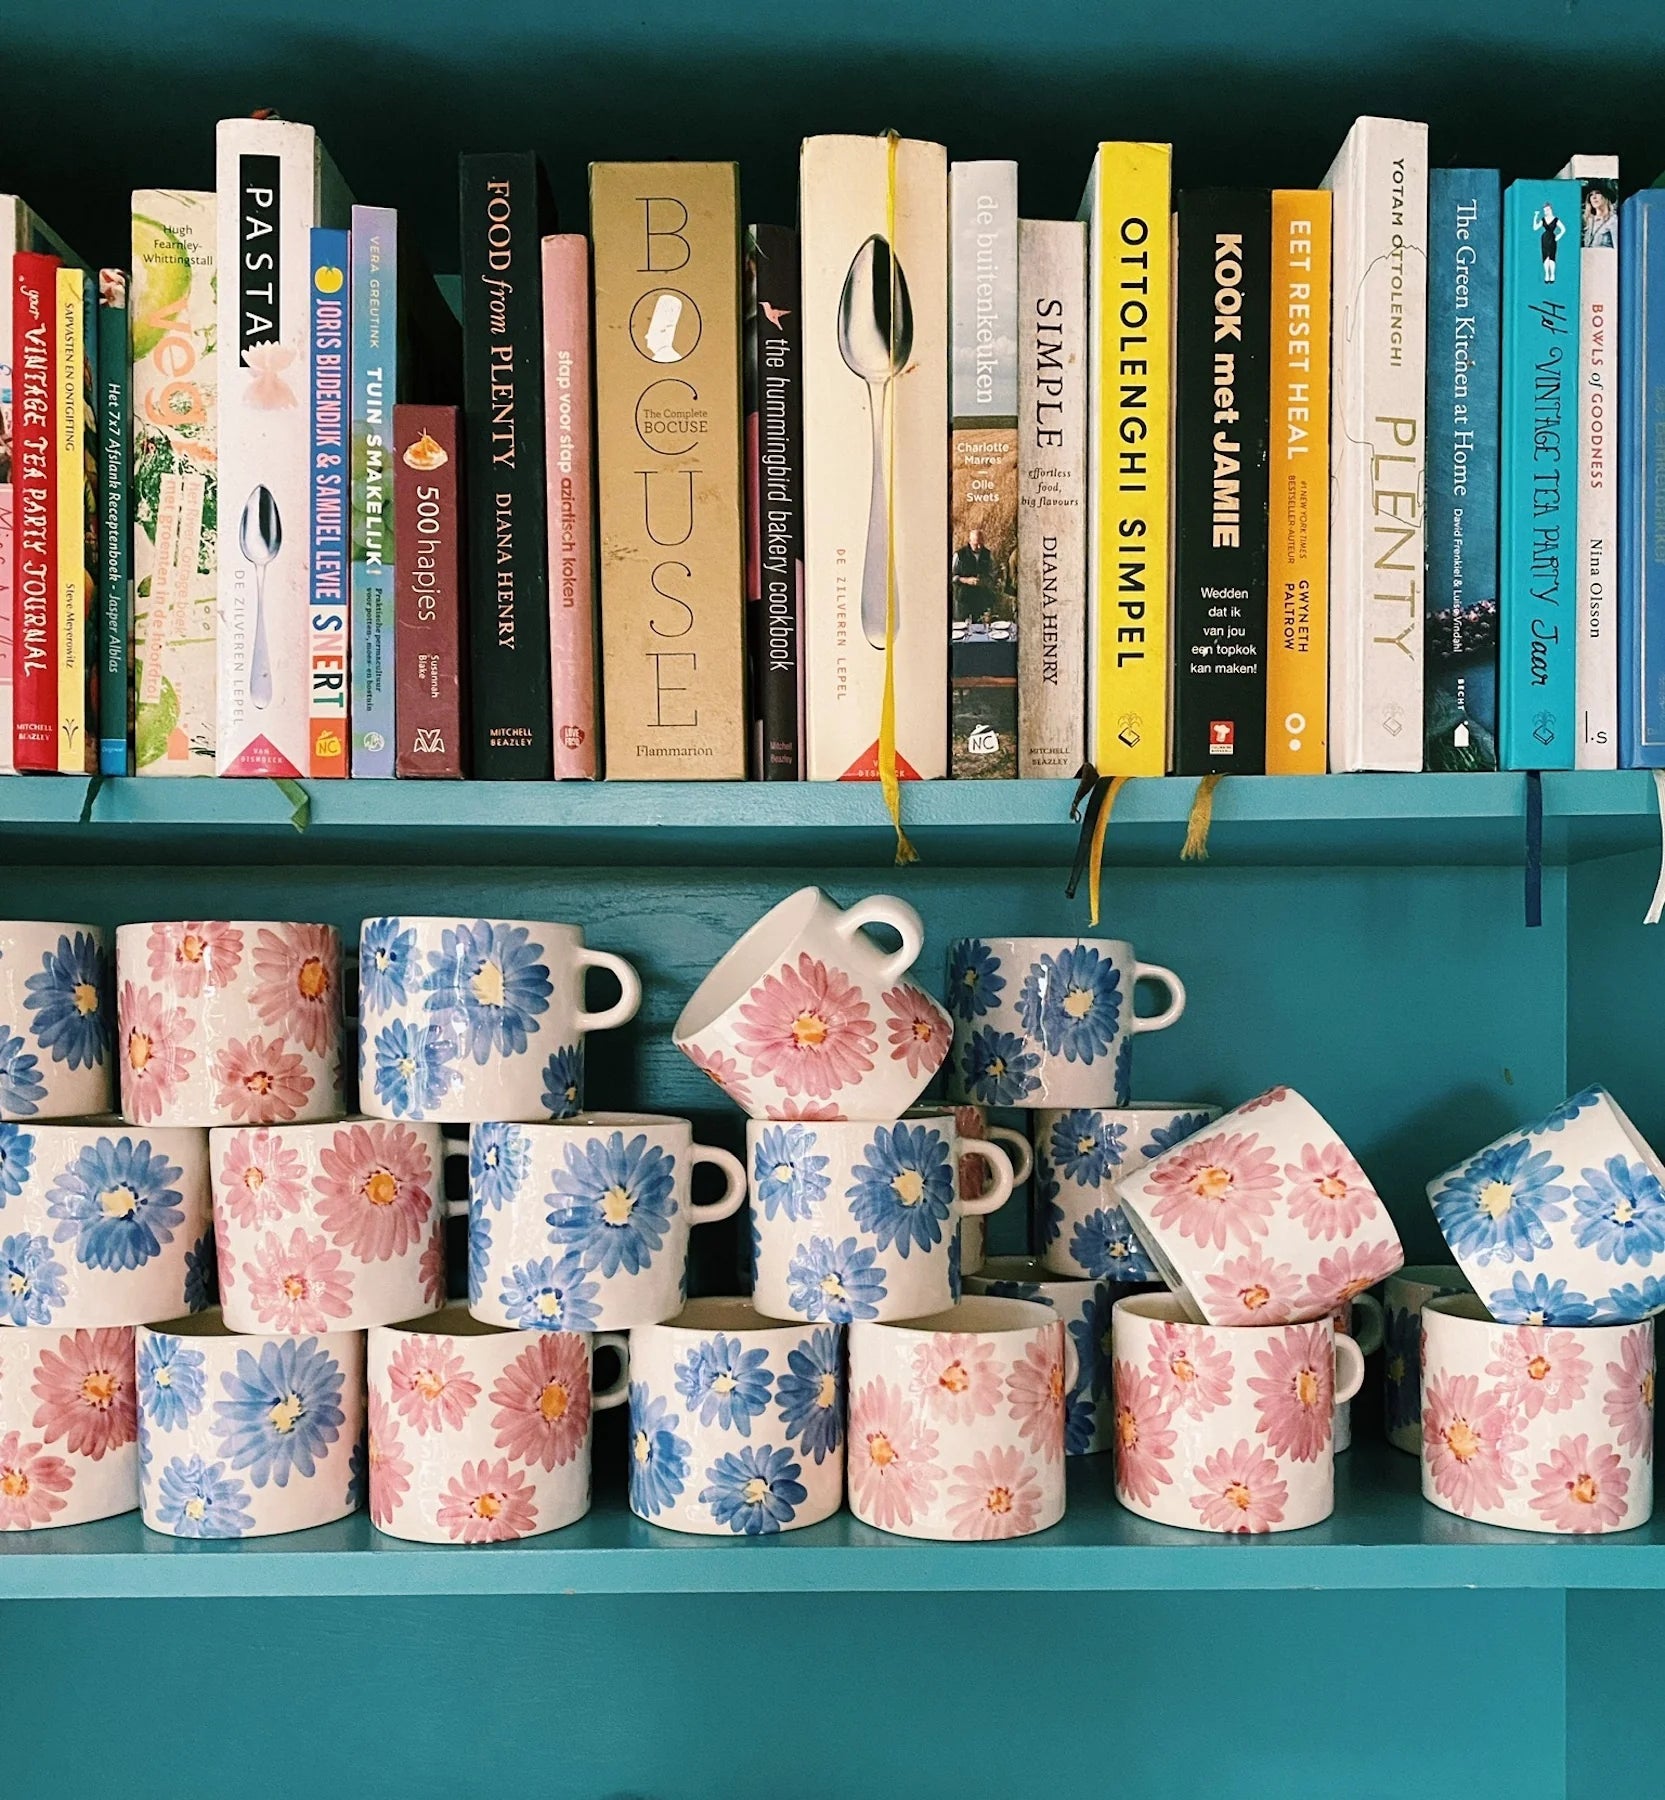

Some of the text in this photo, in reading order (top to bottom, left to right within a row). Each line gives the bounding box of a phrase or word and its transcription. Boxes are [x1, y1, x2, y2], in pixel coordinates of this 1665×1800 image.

[154, 239, 203, 252] Fearnley-
[163, 224, 193, 236] Hugh
[143, 254, 213, 267] Whittingstall
[246, 188, 273, 335] PASTA
[1390, 158, 1404, 367] YOTAM OTTOLENGHI
[369, 236, 380, 348] VERA GREUTINK
[977, 195, 998, 404] de buitenkeuken
[1287, 220, 1312, 460] EET RESET HEAL
[1454, 199, 1477, 496] The Green Kitchen at Home
[23, 322, 47, 428] VINTAGE
[64, 302, 75, 451] SAPVASTEN EN ONTGIFTING
[108, 383, 121, 406] Het
[1036, 298, 1063, 448] SIMPLE
[1212, 233, 1243, 548] KOOK met JAMIE
[108, 410, 121, 436] 7x7
[481, 180, 516, 649] FOOD from PLENTY DIANA HENRY
[643, 408, 708, 420] The Complete
[1533, 346, 1563, 462] VINTAGE
[316, 299, 341, 599] JORIS BIJDENDIJK & SAMUEL LEVIE
[644, 421, 708, 434] BOCUSE
[957, 443, 1009, 453] Charlotte
[1117, 217, 1149, 668] OTTOLENGHI SIMPEL
[23, 436, 48, 480] TEA
[105, 438, 121, 486] Afslank
[366, 367, 383, 575] TUIN SMAKELIJK!
[557, 351, 577, 608] stap voor stap aziatisch koken
[629, 197, 704, 726] BOCUSE
[964, 456, 1002, 465] Marres
[1028, 468, 1071, 480] effortless
[1589, 304, 1604, 638] BOWLS of GOODNESS Nina Olsson
[762, 338, 794, 671] the hummingbird bakery cookbook
[966, 493, 999, 502] Swets
[971, 480, 995, 490] Olle
[1021, 496, 1079, 508] big flavours
[1036, 482, 1062, 494] food,
[1533, 469, 1561, 518] TEA
[23, 488, 47, 555] PARTY
[106, 491, 121, 583] Receptenboek
[1374, 416, 1416, 661] PLENTY
[1453, 508, 1463, 537] David
[412, 485, 442, 621] 500 hapjes
[1299, 536, 1307, 559] TIMES
[1453, 540, 1463, 578] Frenkiel
[1530, 525, 1560, 606] PARTY
[146, 480, 178, 699] met groenten in de hoofdrol
[1201, 587, 1249, 599] Wedden
[1453, 579, 1462, 587] &
[23, 560, 47, 677] JOURNAL
[63, 584, 75, 668] Steve Meyerowitz
[106, 592, 121, 634] Jasper
[837, 549, 846, 700] DE ZILVEREN LEPEL
[1043, 536, 1058, 686] DIANA HENRY
[1203, 625, 1246, 638] van jou
[1208, 607, 1241, 618] dat ik
[1284, 583, 1295, 650] PALTROW
[1298, 580, 1309, 652] GWYNETH
[108, 637, 121, 673] Alblas
[233, 570, 245, 725] DE ZILVEREN LEPEL
[374, 587, 383, 692] Praktische permacultuur
[1191, 644, 1257, 657] een topkok
[1453, 616, 1463, 652] Vindahl
[1531, 618, 1558, 686] Jaar
[312, 614, 344, 708] SNERT
[366, 668, 373, 678] en
[418, 654, 427, 680] Blake
[431, 654, 440, 698] Susannah
[1190, 663, 1258, 673] kan maken!
[366, 680, 374, 711] bostuin
[1457, 678, 1465, 710] BECHT
[16, 723, 53, 732] MITCHELL
[18, 733, 51, 741] BEAZLEY
[319, 743, 338, 754] NC
[490, 728, 533, 737] MITCHELL
[490, 738, 533, 746] BEAZLEY
[770, 741, 793, 750] Mitchell
[972, 736, 994, 750] NC
[636, 745, 713, 757] Flammarion
[1032, 758, 1068, 766] BEAZLEY
